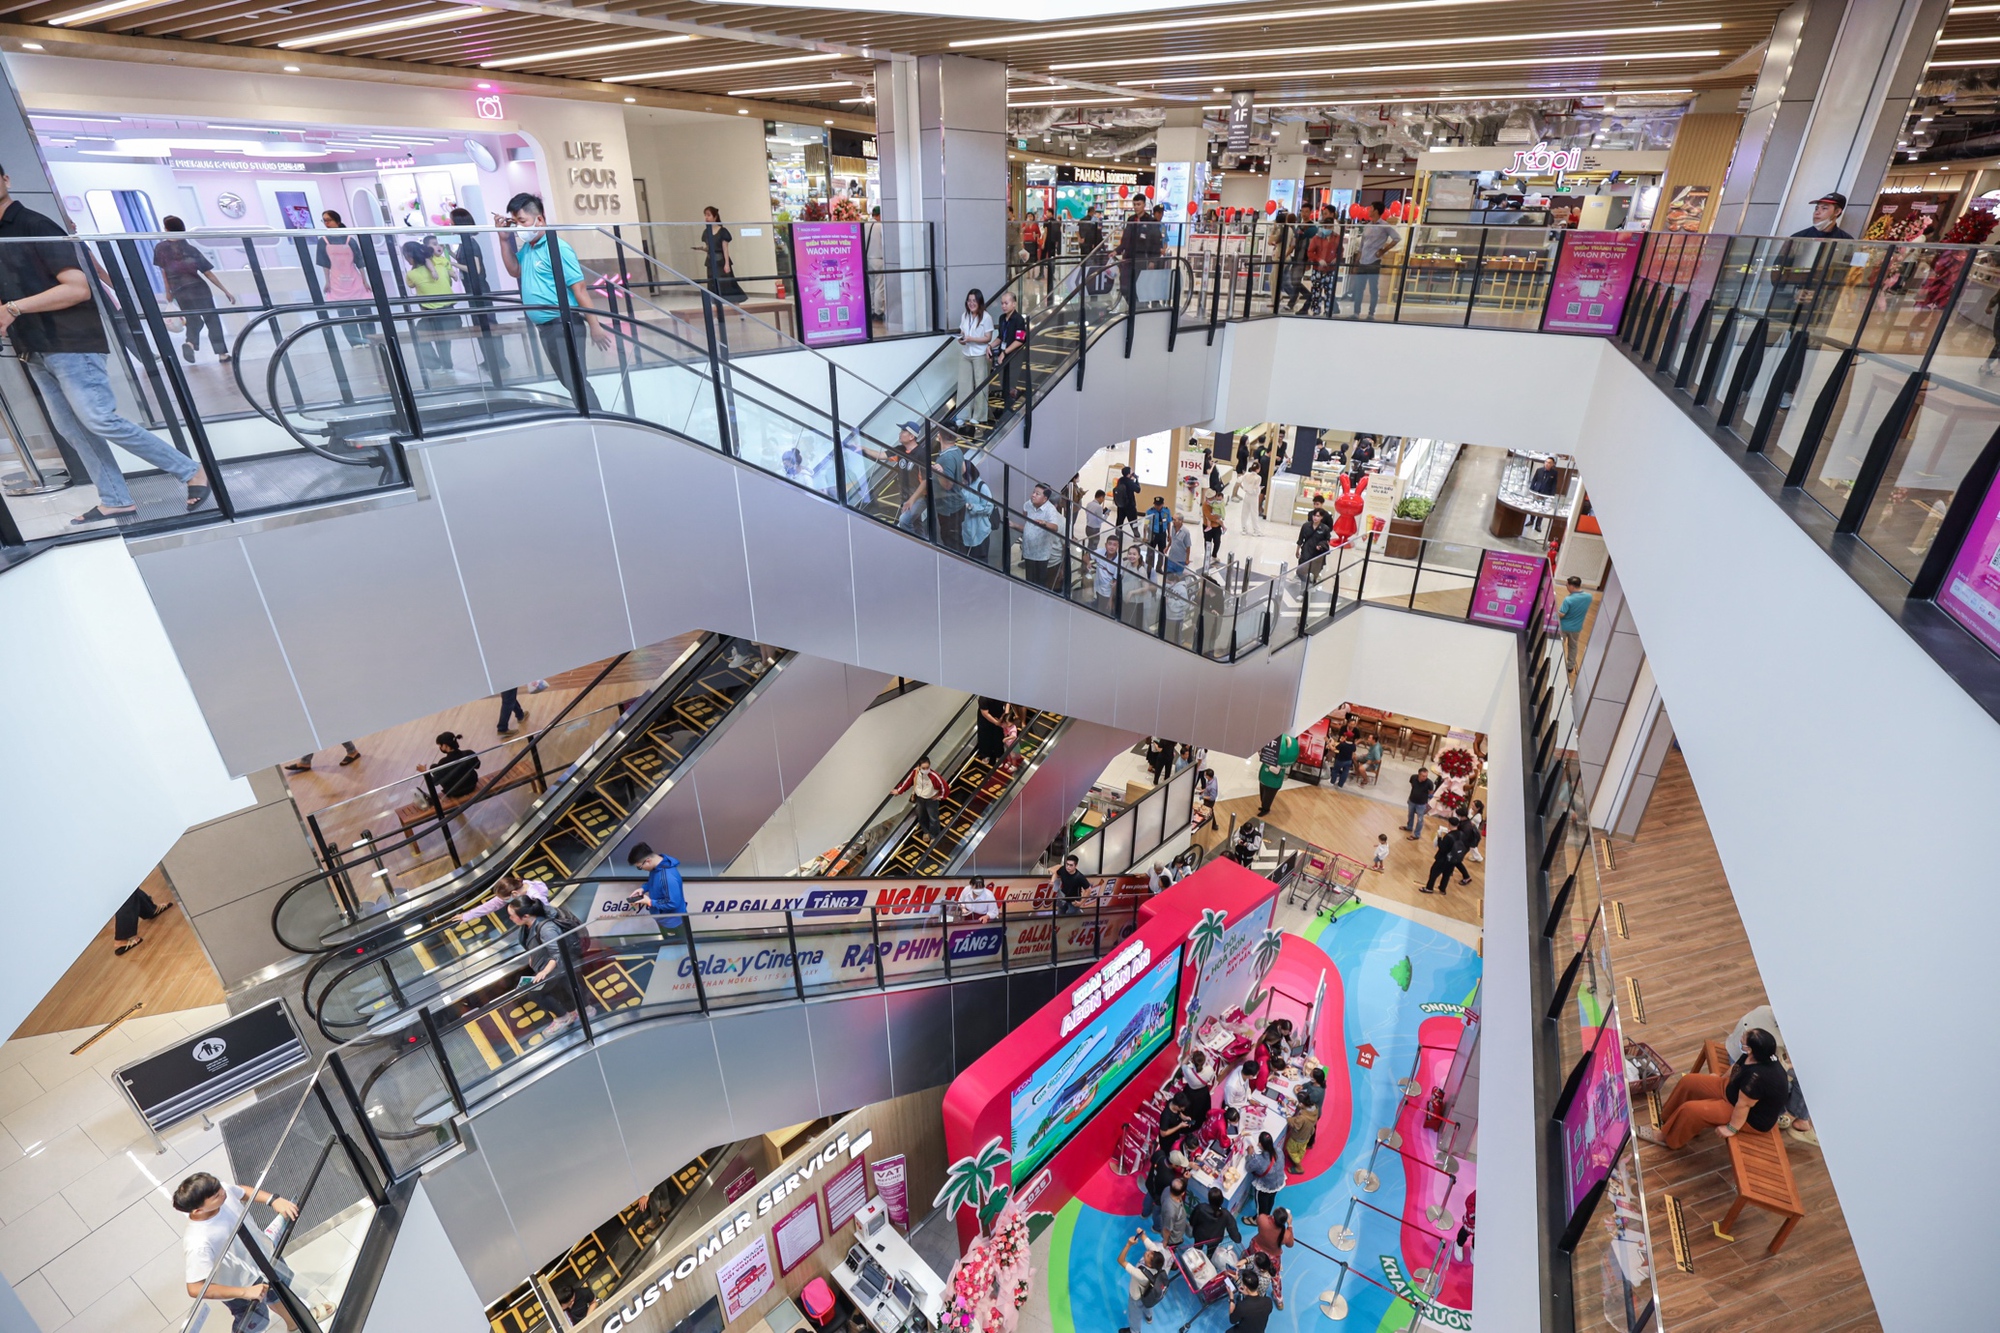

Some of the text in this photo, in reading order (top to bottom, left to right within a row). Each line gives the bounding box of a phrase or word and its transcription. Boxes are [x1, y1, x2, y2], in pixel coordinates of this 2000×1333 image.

[1233, 108, 1248, 121] 1F
[564, 141, 603, 160] LIFE
[175, 160, 213, 169] PREMIUM
[214, 161, 249, 170] K-PHOTO
[250, 162, 277, 170] STUDIO
[569, 167, 617, 186] FOUR
[1074, 168, 1137, 184] FAHASA BOOKSTORE
[574, 193, 621, 211] CUTS
[1180, 460, 1202, 470] 119K
[1491, 565, 1532, 575] WAON POINT
[702, 891, 859, 919] RẠP GALAXY TẦNG 2
[841, 931, 999, 972] RẠP PHIM TẦNG 2
[1013, 944, 1033, 956] AEON
[1033, 941, 1046, 954] TÂN
[677, 948, 824, 977] Galaxy Cinema
[672, 983, 698, 991] MORE
[1060, 948, 1151, 1038] AEON TÂN AN
[1072, 972, 1101, 1007] KHAI
[1360, 1057, 1370, 1065] RA
[877, 1166, 902, 1178] VAT
[602, 1131, 851, 1333] CUSTOMER SERVICE
[1381, 1256, 1412, 1298] KHAI
